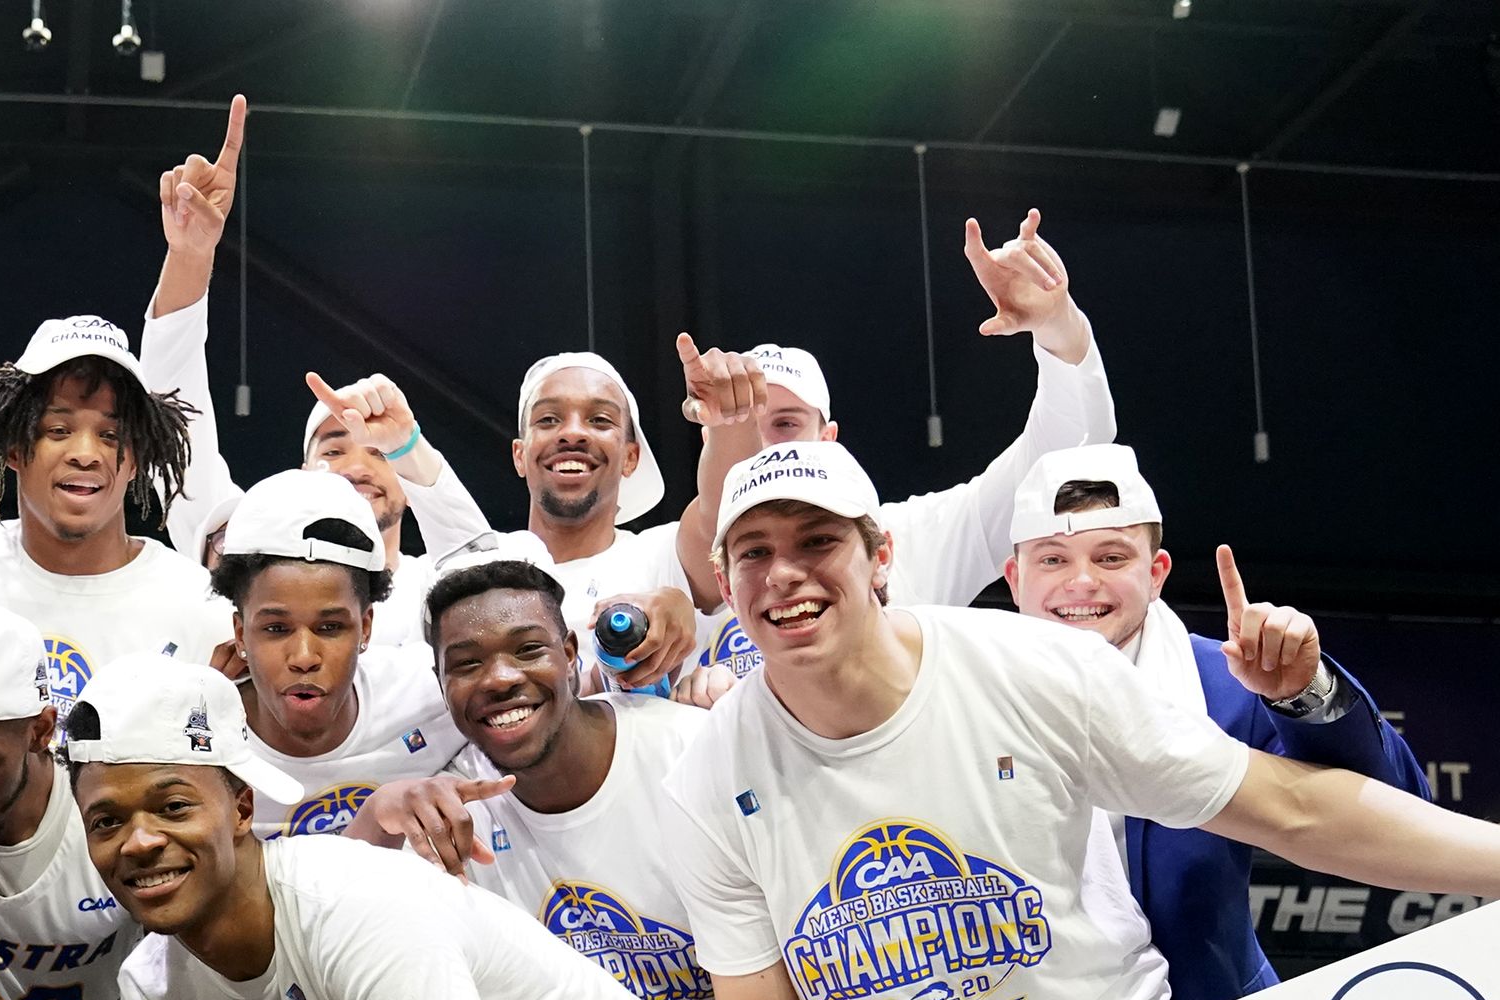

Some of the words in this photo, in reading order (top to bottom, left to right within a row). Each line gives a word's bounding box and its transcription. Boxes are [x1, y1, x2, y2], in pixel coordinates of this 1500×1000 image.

[750, 449, 800, 471] CAA
[731, 467, 829, 504] CHAMPIONS
[306, 809, 353, 834] CA
[855, 851, 934, 888] CAA
[78, 896, 117, 912] CAA
[809, 899, 867, 936] MEN'S
[869, 875, 1007, 918] BASKETBALL
[1248, 885, 1371, 933] THE
[559, 907, 616, 930] CAA
[570, 929, 680, 951] BASKETBALL
[961, 975, 990, 997] 20
